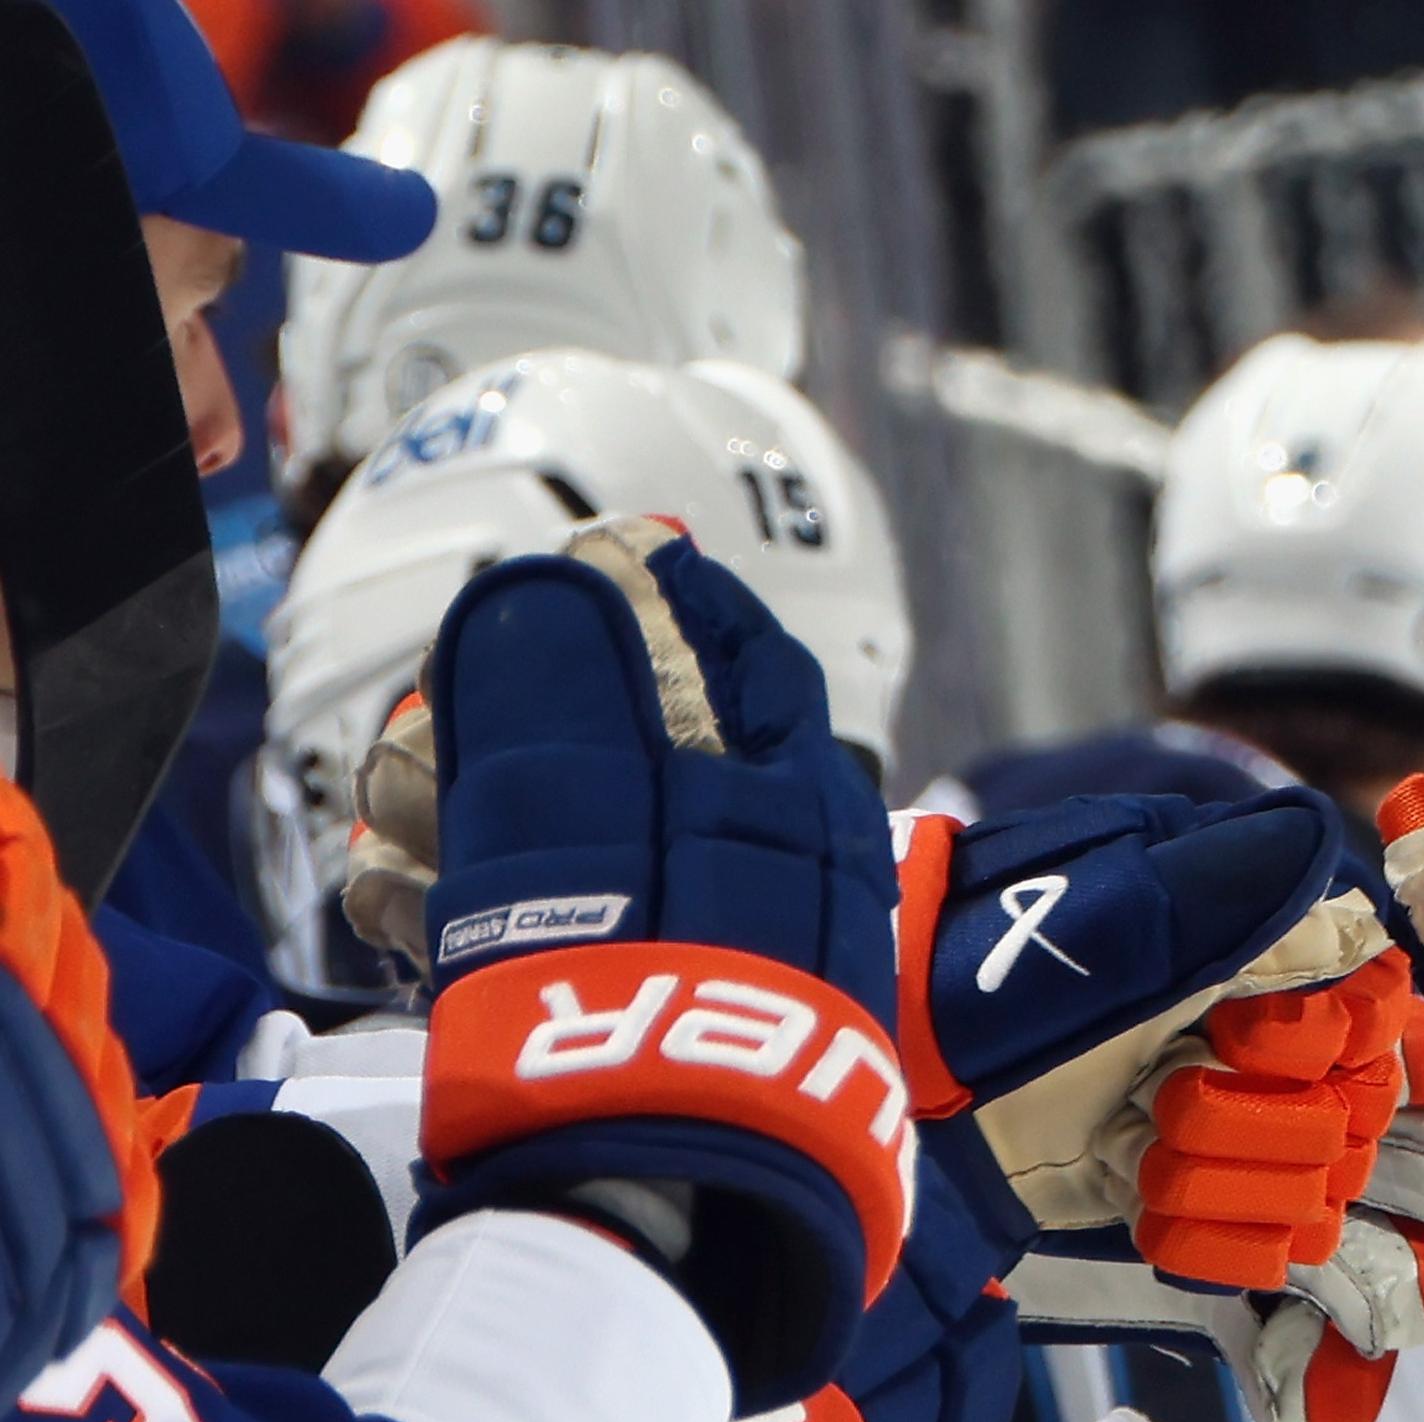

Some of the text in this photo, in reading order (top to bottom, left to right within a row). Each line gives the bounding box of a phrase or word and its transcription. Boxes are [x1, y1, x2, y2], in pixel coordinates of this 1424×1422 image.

[464, 172, 585, 251] 36
[737, 467, 827, 549] 15
[516, 903, 608, 931] PRO
